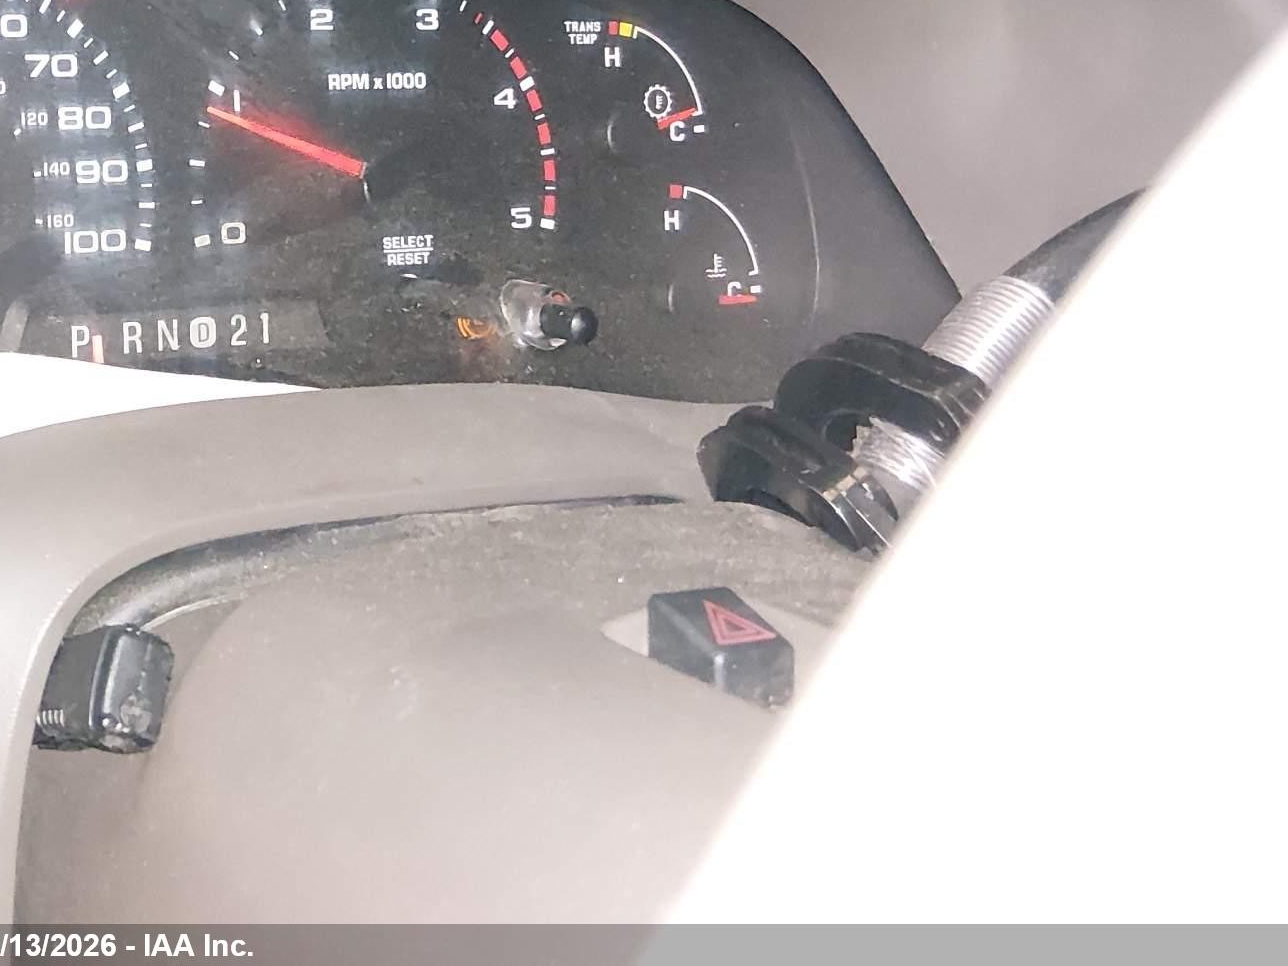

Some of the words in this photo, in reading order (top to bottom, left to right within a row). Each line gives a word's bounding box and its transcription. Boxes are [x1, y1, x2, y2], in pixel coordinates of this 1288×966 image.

[311, 9, 333, 30] 2
[416, 9, 438, 30] 3
[564, 21, 601, 33] TRANS
[569, 34, 597, 44] TEMP
[25, 53, 77, 77] 70
[605, 47, 620, 67] H
[328, 74, 369, 90] RPM
[374, 78, 383, 89] x
[387, 73, 426, 89] 1000
[234, 90, 240, 111] 1
[494, 88, 516, 108] 4
[21, 112, 48, 127] 120
[58, 106, 111, 130] 80
[670, 121, 685, 141] C
[44, 162, 70, 176] 140
[76, 160, 128, 185] 90
[48, 214, 73, 228] 160
[511, 208, 532, 228] 5
[664, 210, 679, 230] H
[65, 229, 126, 253] 100
[221, 222, 245, 244] 0
[383, 235, 433, 248] SELECT
[387, 252, 429, 265] RESET
[72, 326, 89, 357] P
[123, 322, 142, 354] R
[158, 319, 179, 351] N
[231, 315, 246, 345] 2
[261, 313, 269, 343] 1
